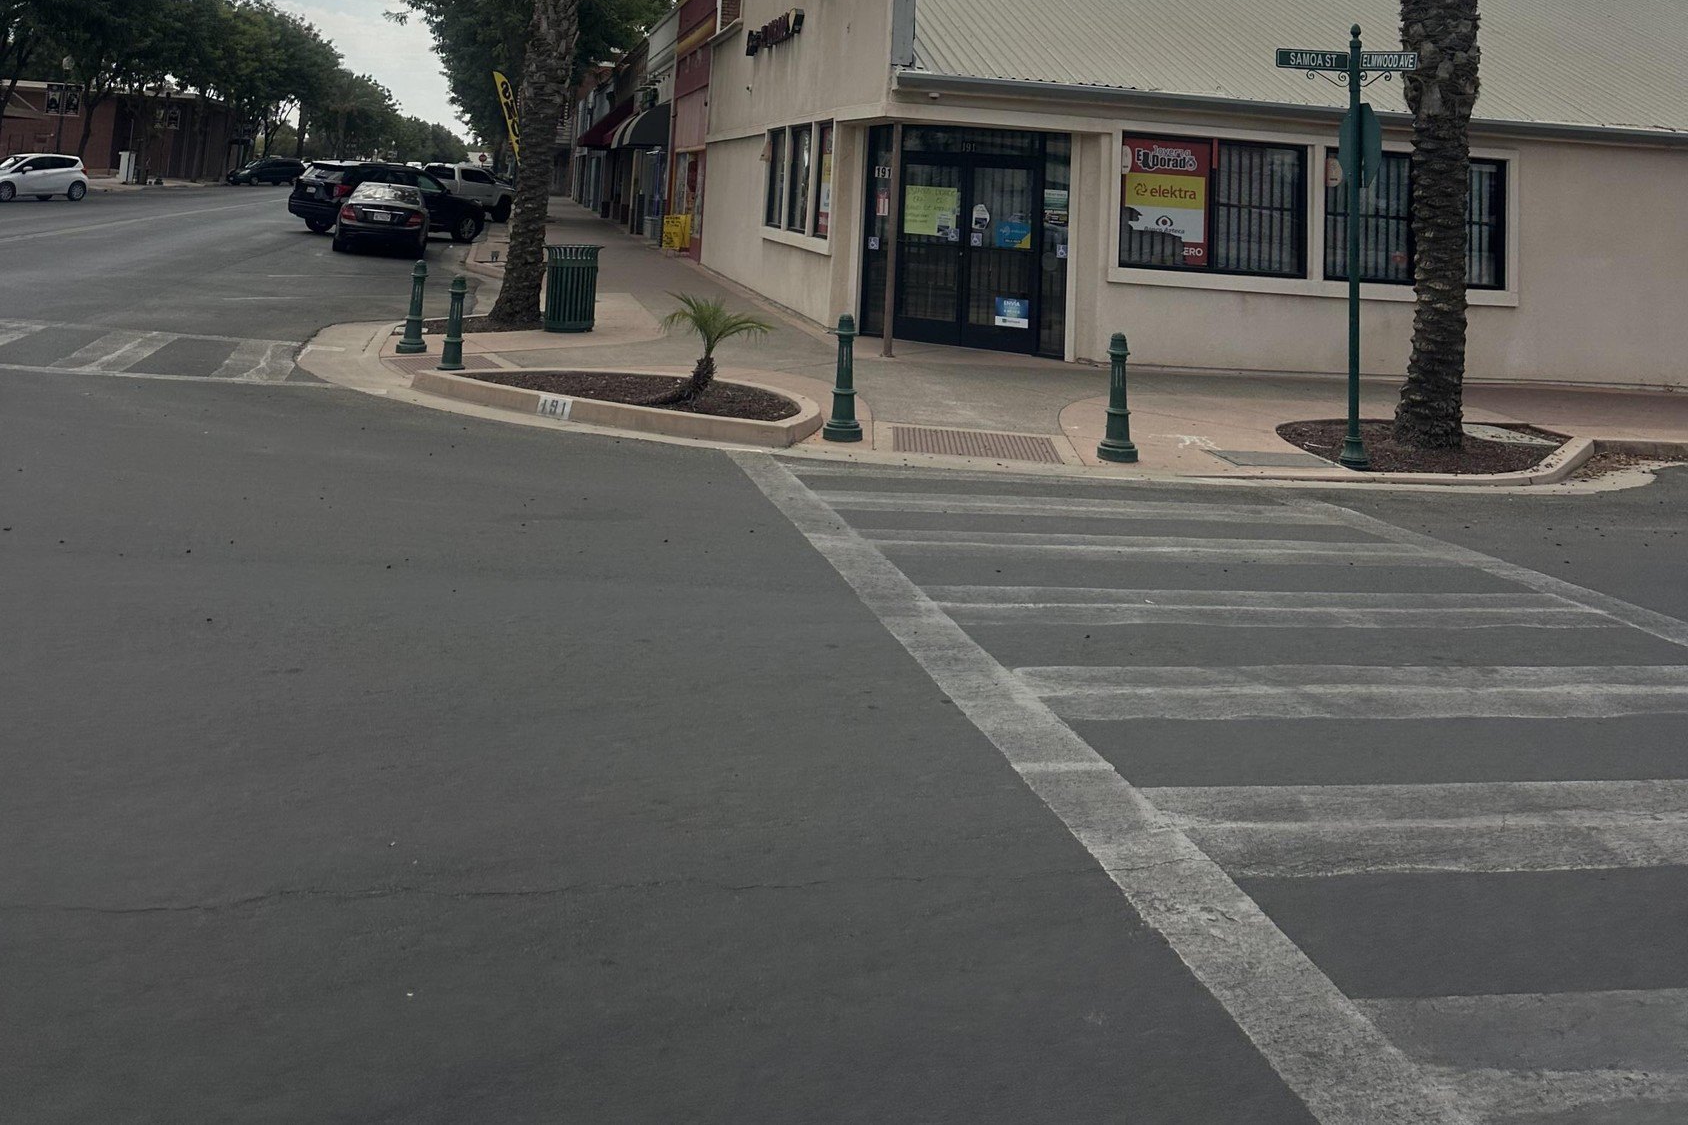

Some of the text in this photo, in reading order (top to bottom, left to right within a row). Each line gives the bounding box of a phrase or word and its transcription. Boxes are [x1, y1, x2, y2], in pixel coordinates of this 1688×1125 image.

[1289, 52, 1337, 67] SAMOA ST
[1362, 54, 1414, 68] ELMWOOD AVE
[876, 167, 891, 178] 191
[1150, 183, 1197, 200] elektra
[1181, 246, 1204, 257] ERO
[541, 399, 566, 415] 191
